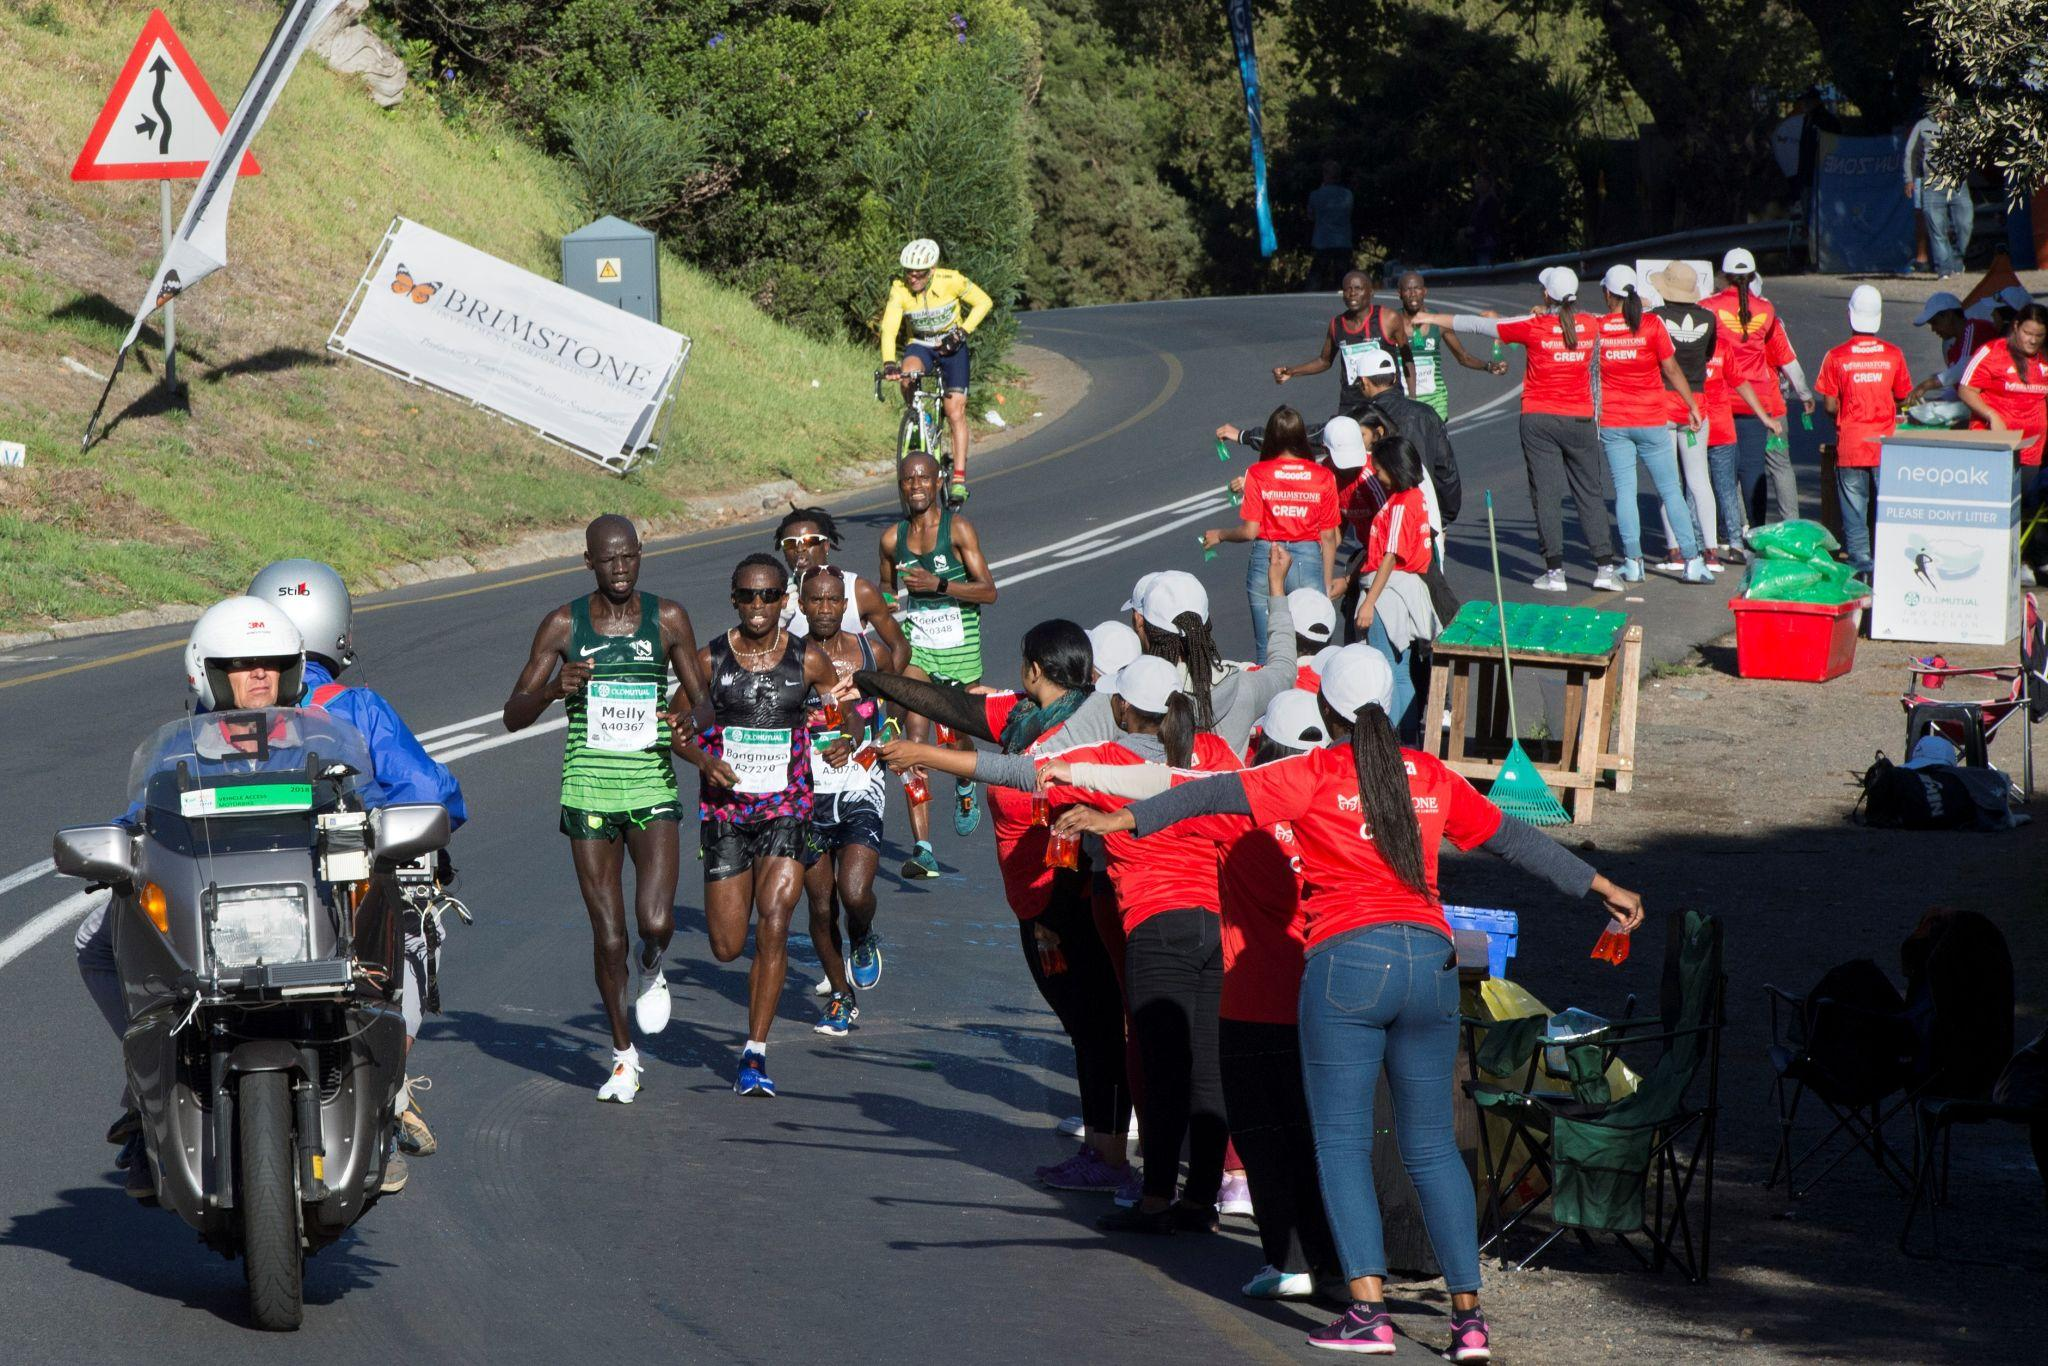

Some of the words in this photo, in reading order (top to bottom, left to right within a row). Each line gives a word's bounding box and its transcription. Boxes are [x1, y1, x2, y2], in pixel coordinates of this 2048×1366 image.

[444, 288, 652, 391] BRIMSTONE
[1604, 336, 1647, 346] BRIMSTONE
[1554, 351, 1585, 362] CREW
[1605, 349, 1637, 360] CREW
[1853, 372, 1883, 383] CREW
[1898, 465, 1989, 487] neopak
[1272, 490, 1321, 501] BRIMSTONE
[1272, 505, 1308, 518] CREW
[1886, 507, 1924, 520] PLEASE
[1928, 510, 1962, 521] DON'T
[1965, 511, 1998, 524] LITTER
[278, 582, 310, 597] Stilo
[248, 621, 265, 629] 3M
[919, 625, 953, 636] A0348
[602, 706, 646, 721] Melly
[601, 722, 645, 732] A40367
[726, 749, 788, 763] Bongmusa
[735, 763, 776, 774] A27270
